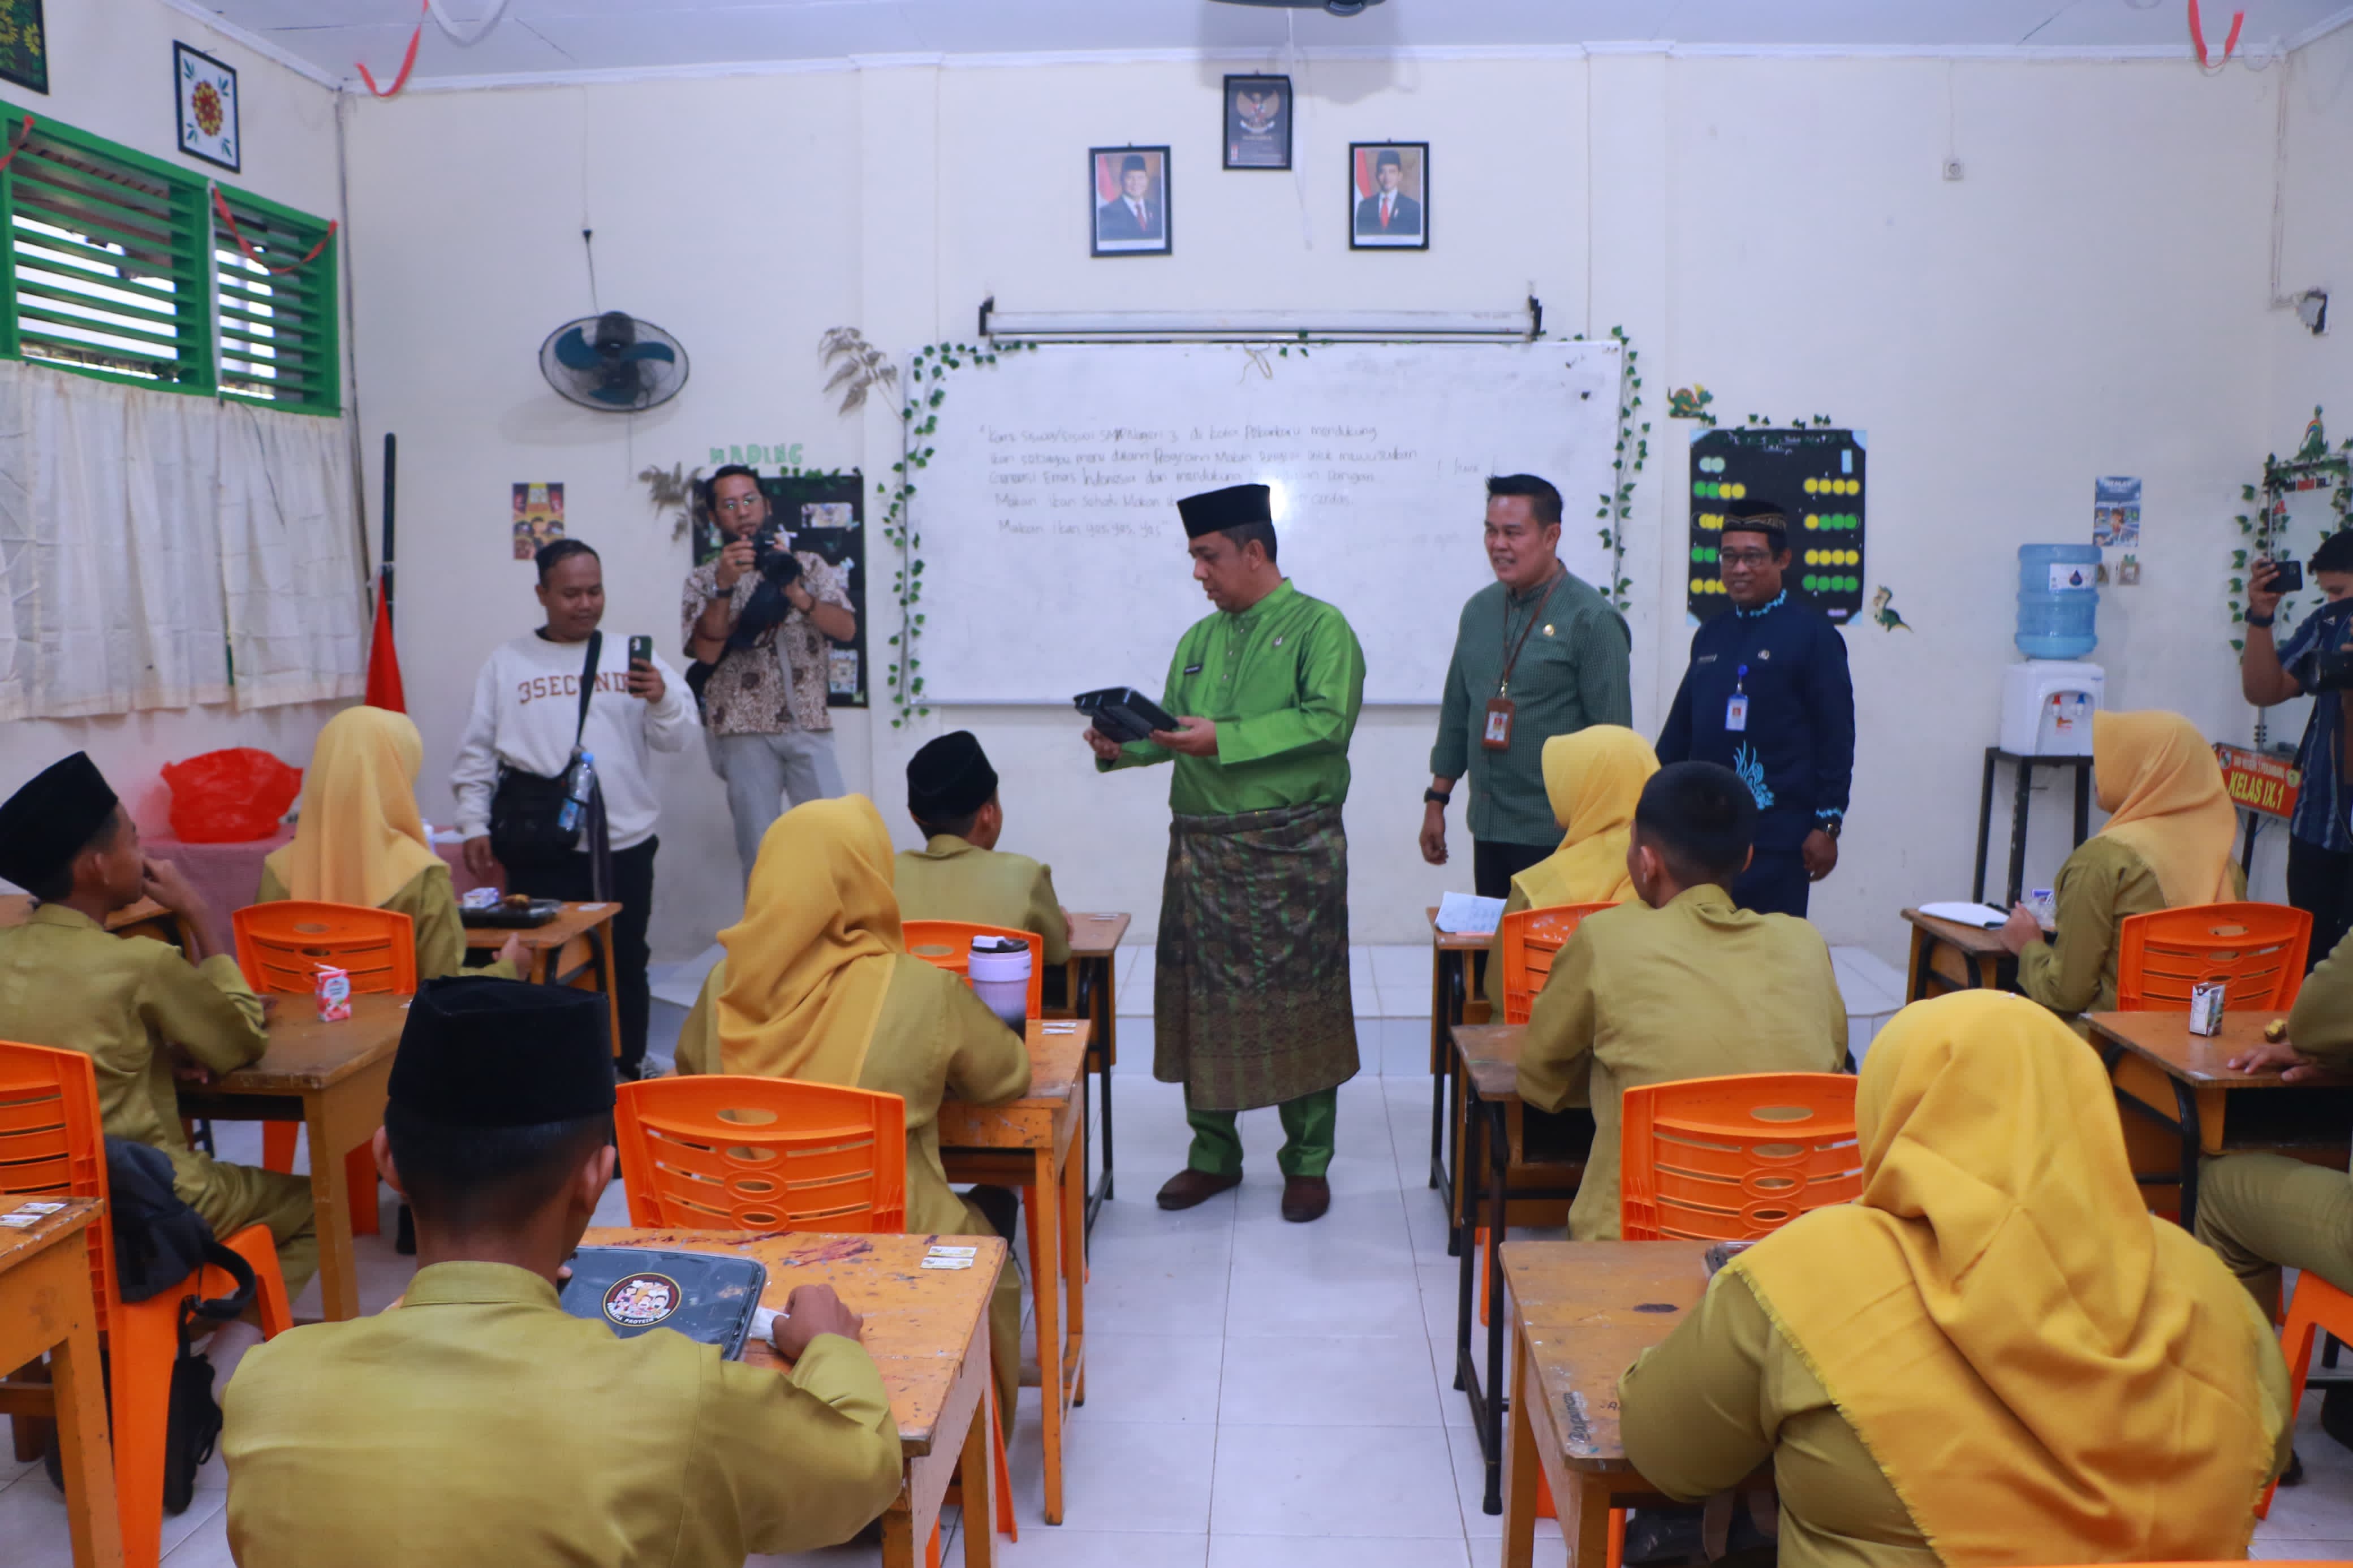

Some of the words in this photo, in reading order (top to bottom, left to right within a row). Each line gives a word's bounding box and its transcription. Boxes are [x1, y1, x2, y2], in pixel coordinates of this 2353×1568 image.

[709, 443, 803, 465] MADING
[518, 672, 627, 705] 3SECND
[2227, 771, 2263, 804] KELAS
[2261, 780, 2285, 810] IX.1
